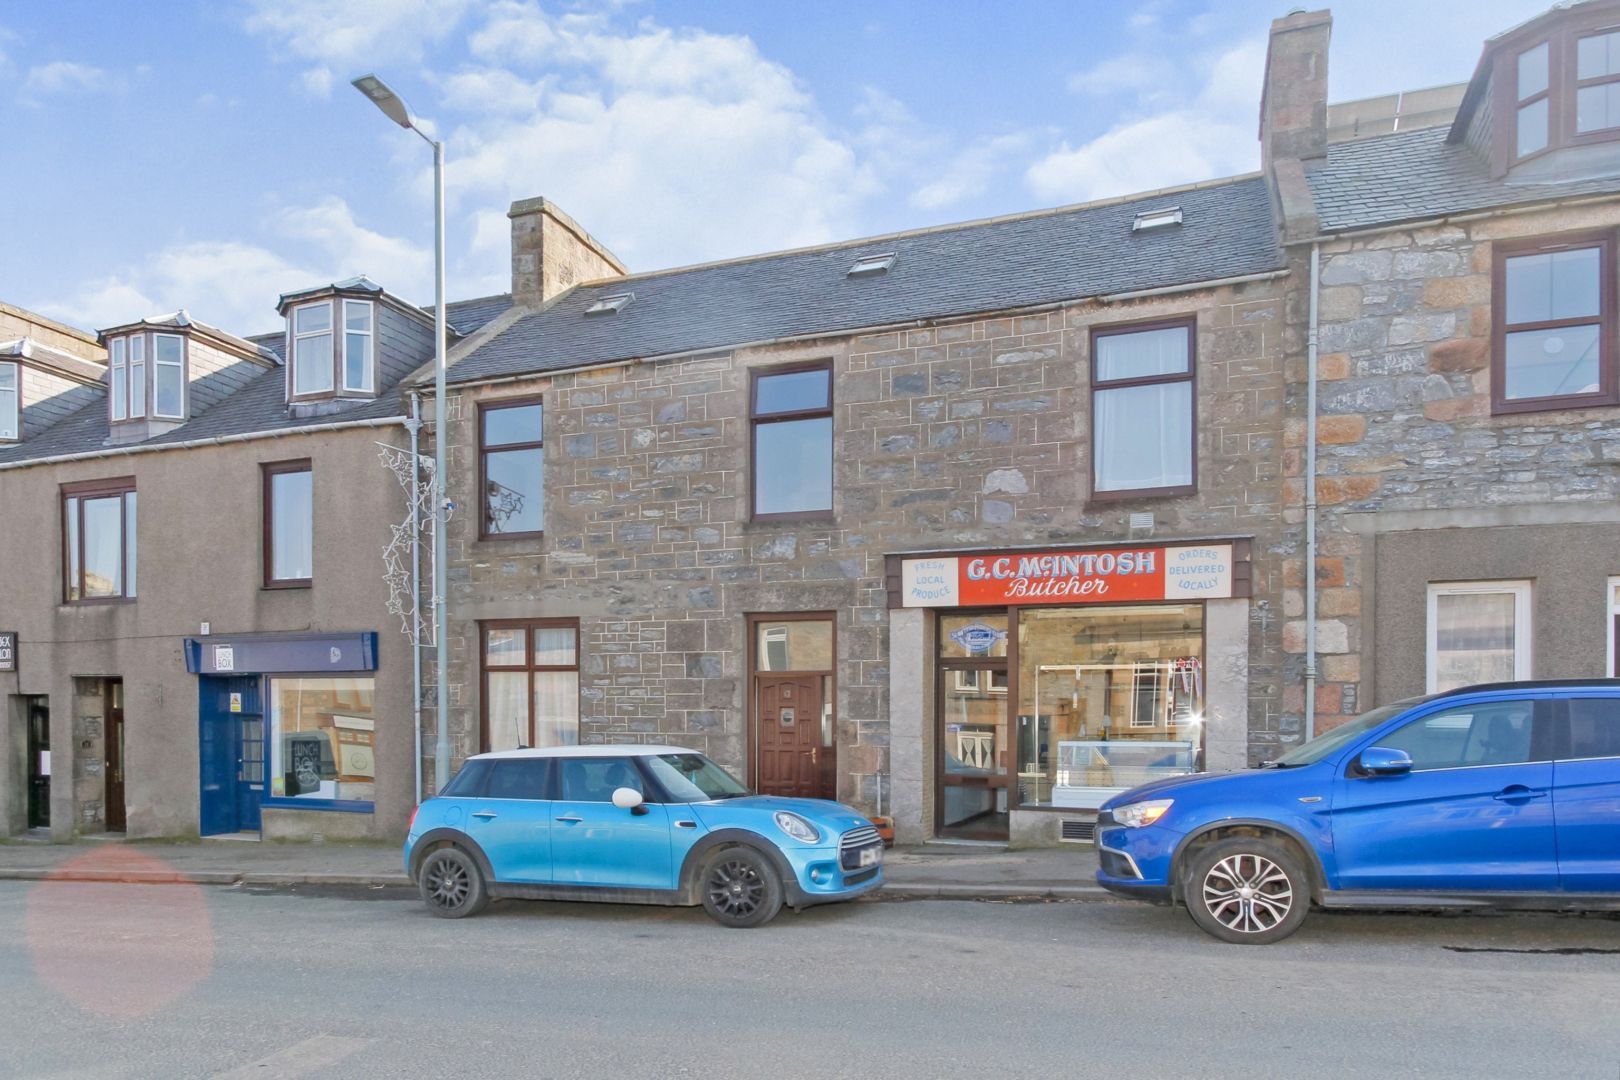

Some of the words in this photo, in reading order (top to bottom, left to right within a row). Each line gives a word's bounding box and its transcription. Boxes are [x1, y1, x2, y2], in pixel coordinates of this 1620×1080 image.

[1179, 549, 1218, 560] ORDERS
[913, 561, 944, 571] FRESH
[1169, 564, 1225, 575] DELIVERED
[916, 576, 944, 585] LOCAL
[1178, 576, 1218, 589] LOCALLY
[1004, 576, 1109, 597] Butcher
[911, 586, 951, 599] PRODUCE
[217, 658, 232, 668] BOX
[294, 743, 319, 756] LUNCH
